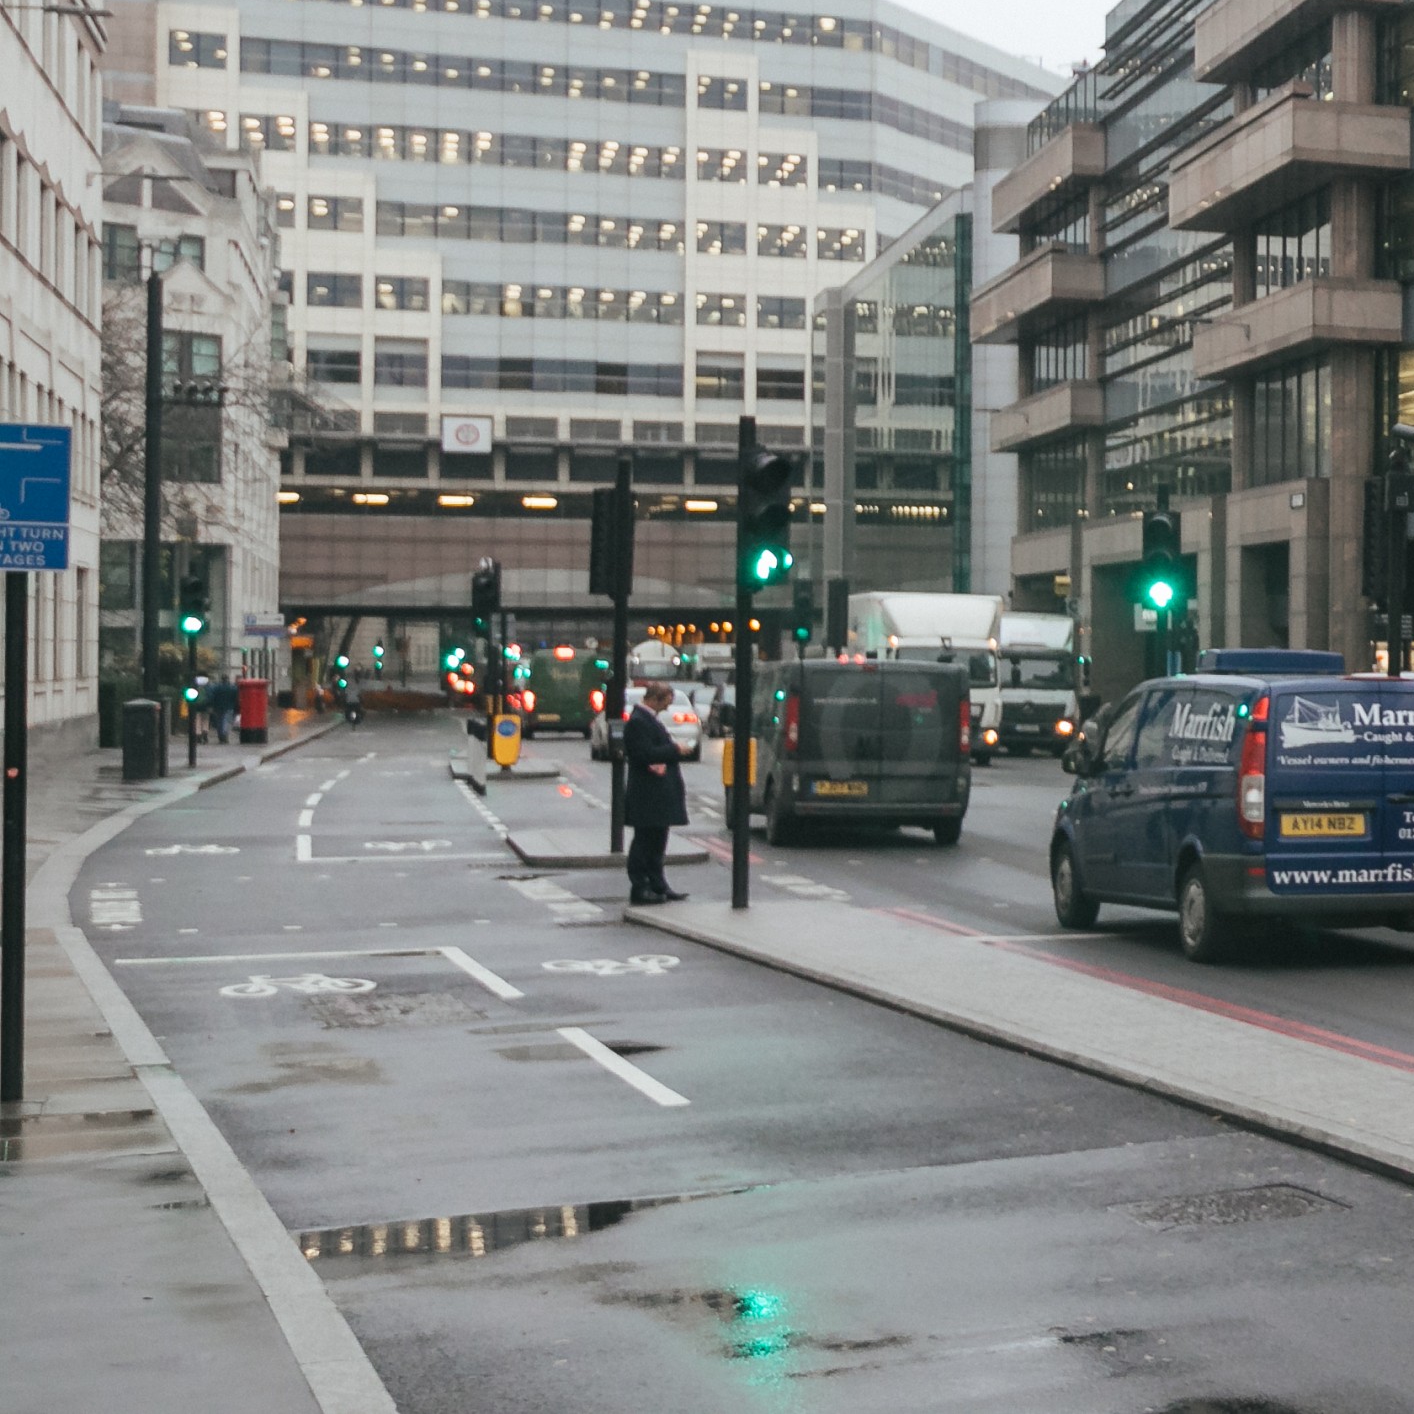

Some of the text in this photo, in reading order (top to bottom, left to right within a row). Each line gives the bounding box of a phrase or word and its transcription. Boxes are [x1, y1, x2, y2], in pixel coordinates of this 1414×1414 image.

[21, 527, 64, 540] TURN
[10, 541, 45, 553] TWO
[1168, 702, 1235, 741] Marrfish
[1363, 731, 1402, 744] Caught
[1404, 732, 1414, 742] &
[1313, 757, 1350, 765] owners
[1351, 755, 1370, 764] and
[1292, 817, 1356, 831] AY14 NBZ
